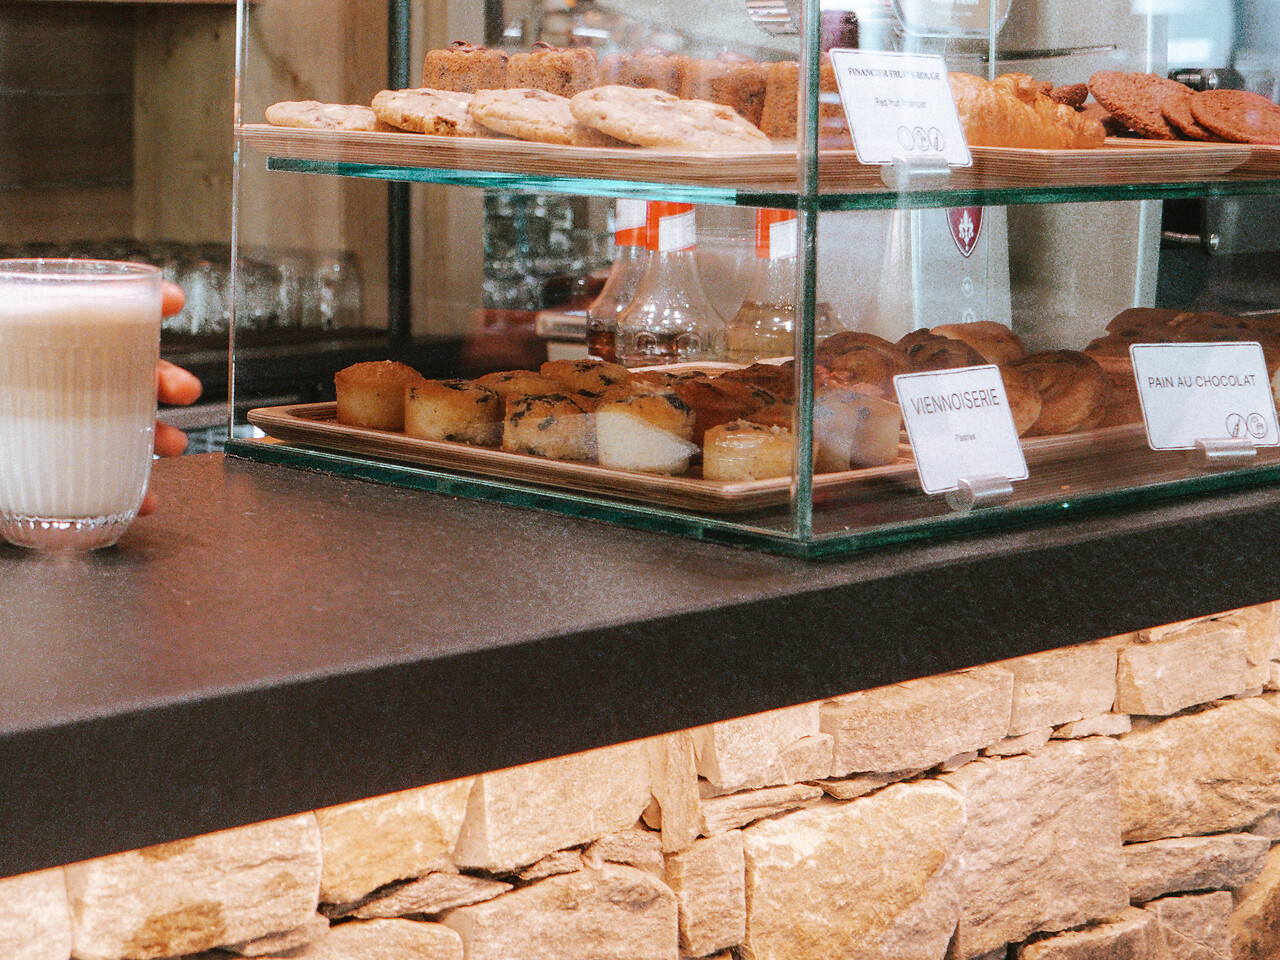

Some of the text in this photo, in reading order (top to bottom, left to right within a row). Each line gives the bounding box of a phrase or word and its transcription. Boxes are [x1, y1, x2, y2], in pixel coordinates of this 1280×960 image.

[847, 67, 889, 78] FINANCIER
[916, 71, 941, 81] ROUGE
[1147, 374, 1256, 388] PAIN AU CHOCOLAT
[911, 388, 1000, 415] VIENNOISERIE
